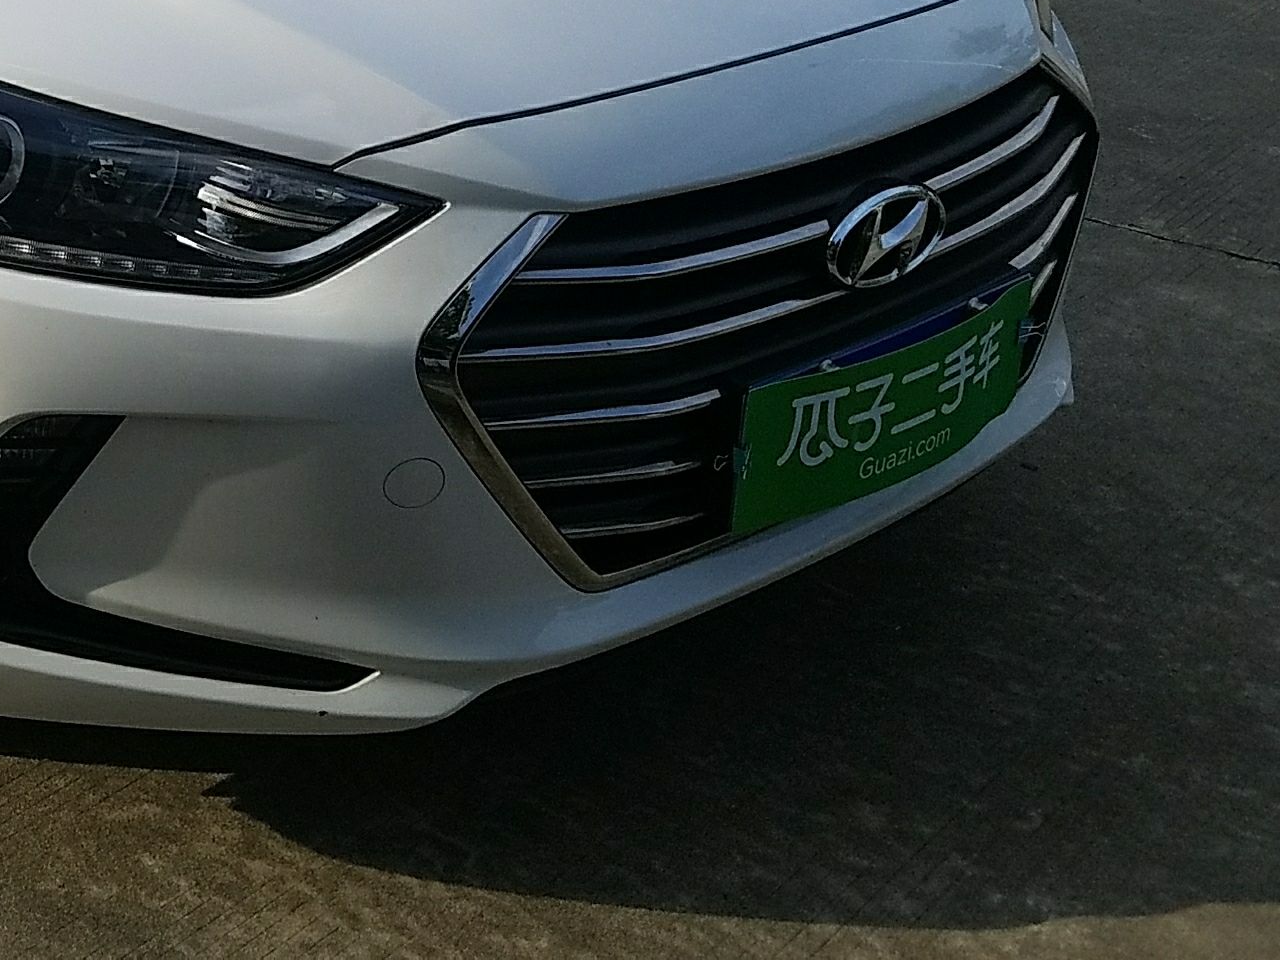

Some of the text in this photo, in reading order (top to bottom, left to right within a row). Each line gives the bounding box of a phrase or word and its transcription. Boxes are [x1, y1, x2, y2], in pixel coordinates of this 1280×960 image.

[776, 319, 1005, 467] 瓜子二手车
[858, 426, 952, 480] Guazi.com
